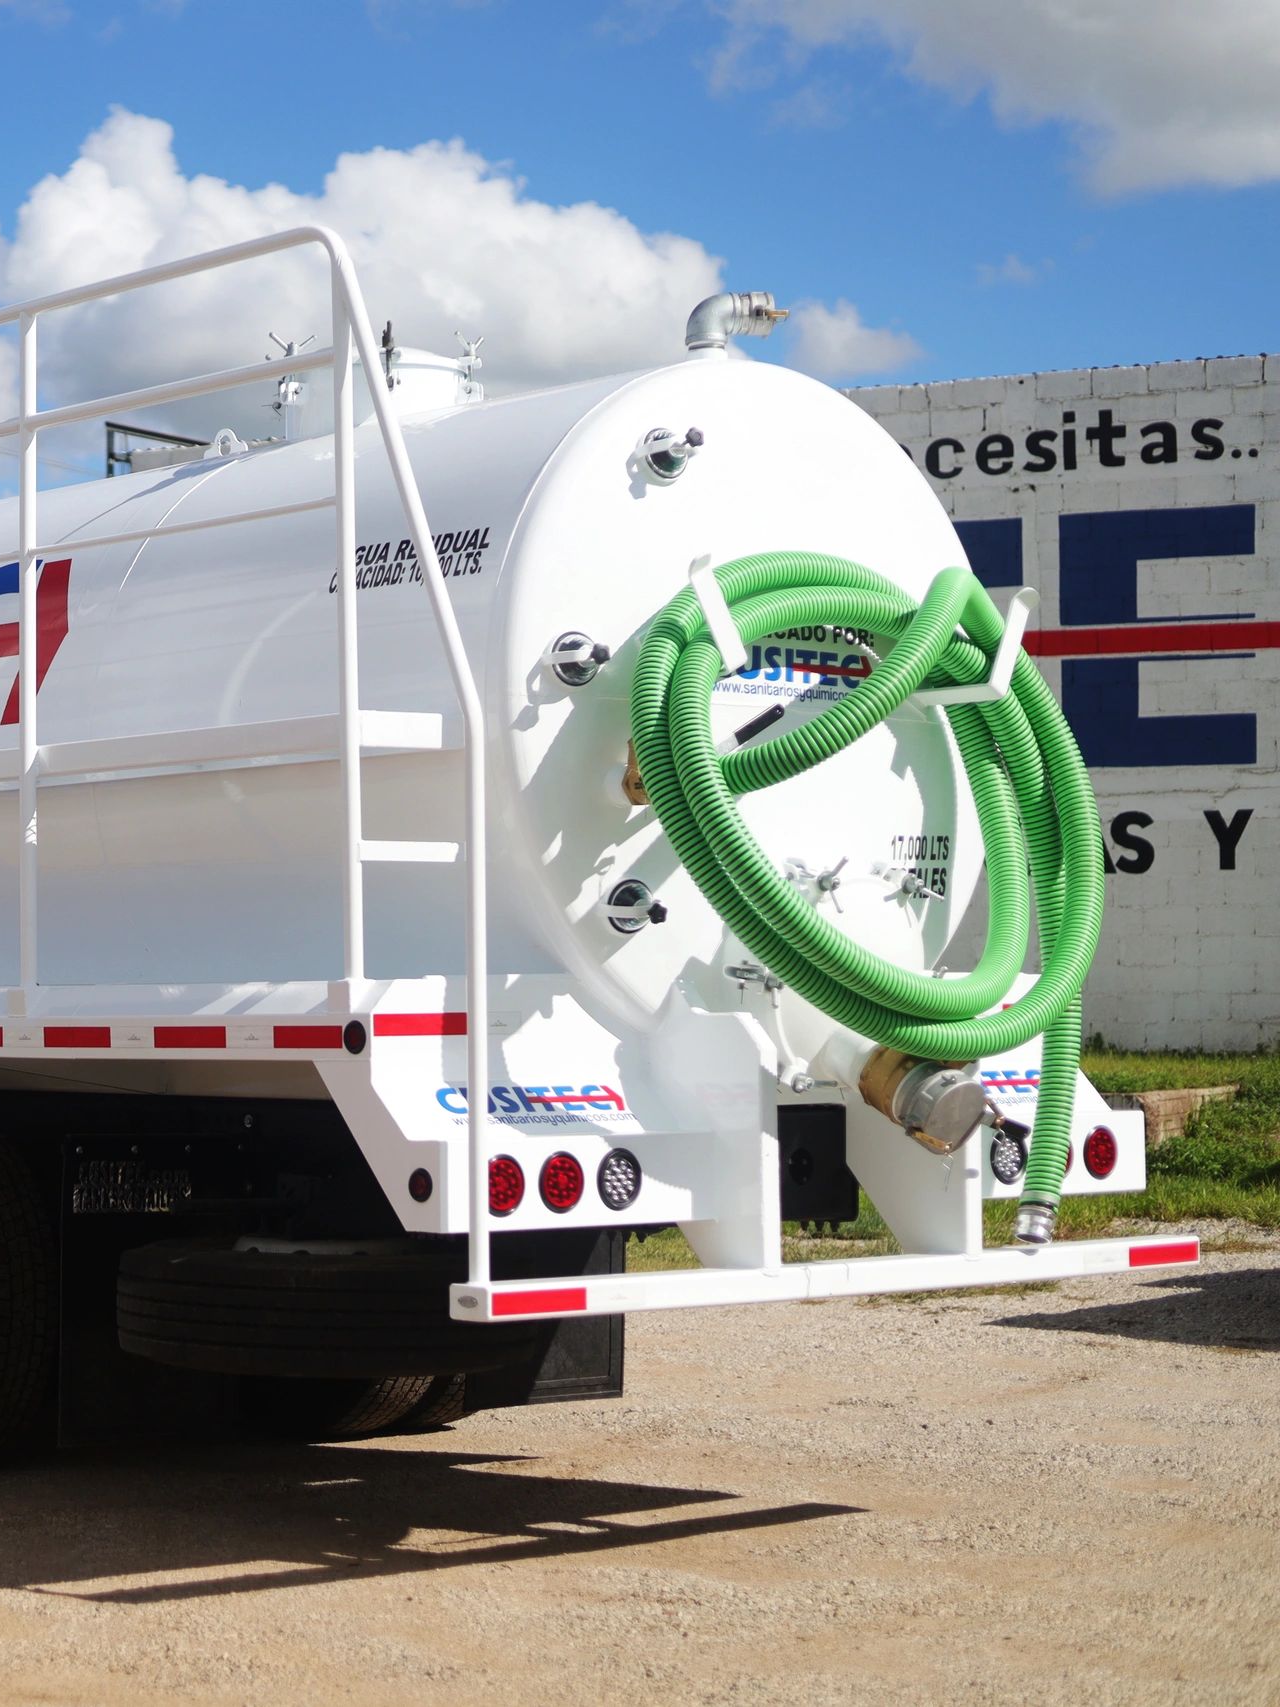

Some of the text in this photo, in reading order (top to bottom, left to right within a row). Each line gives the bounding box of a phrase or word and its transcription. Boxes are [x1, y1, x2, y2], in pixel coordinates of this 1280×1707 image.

[900, 409, 1259, 479] cesitas..
[356, 527, 490, 567] GUA REIDUAL
[329, 561, 406, 594] CACIDAD:
[453, 551, 483, 577] LTS.
[721, 645, 862, 689] USITEC
[891, 835, 950, 865] 17,000 LTS
[1203, 808, 1254, 870] Y
